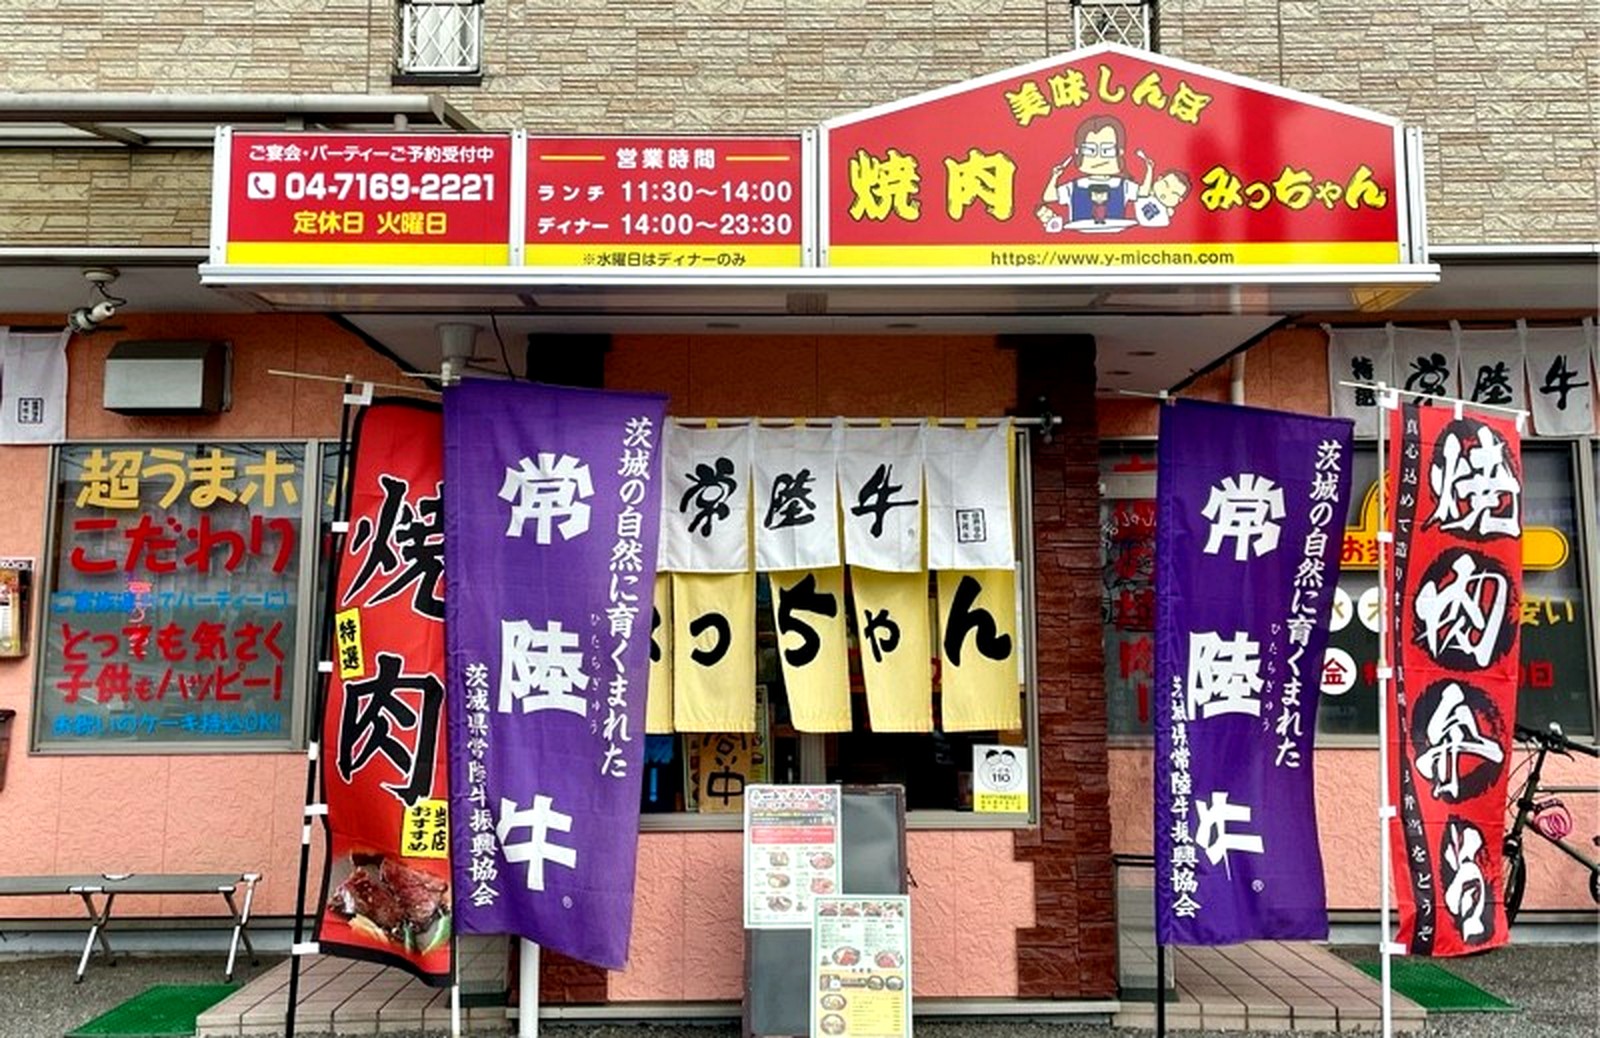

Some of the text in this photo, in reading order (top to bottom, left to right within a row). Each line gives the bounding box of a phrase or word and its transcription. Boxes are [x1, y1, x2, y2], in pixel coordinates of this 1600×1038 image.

[1004, 65, 1213, 125] 美味しんぼ
[249, 144, 494, 163] ご宴会・パーティーご予約受付中
[616, 148, 715, 169] 営業時間
[285, 172, 495, 201] 04-7169-2221
[537, 184, 604, 201] ランチ
[849, 148, 1387, 222] 焼肉 みっちゃん
[293, 211, 447, 235] 定休日 火曜日
[537, 216, 609, 234] ディナー
[990, 250, 1234, 266] https://www.y-micchan.com
[76, 448, 299, 510] 超うまホ
[679, 457, 919, 538] 常陸牛
[71, 513, 296, 574] こだわり
[601, 416, 653, 778] 茨城の自然に育くまれた
[650, 573, 1013, 668] っちゃん
[1275, 440, 1343, 768] 茨城の自然に育くまれた
[61, 620, 285, 662] とっても気さく
[337, 473, 446, 806] 焼肉
[339, 618, 361, 671] 特選
[497, 453, 595, 891] 常陸牛
[1187, 474, 1286, 880] 常陸牛
[408, 806, 431, 852] おすすめ
